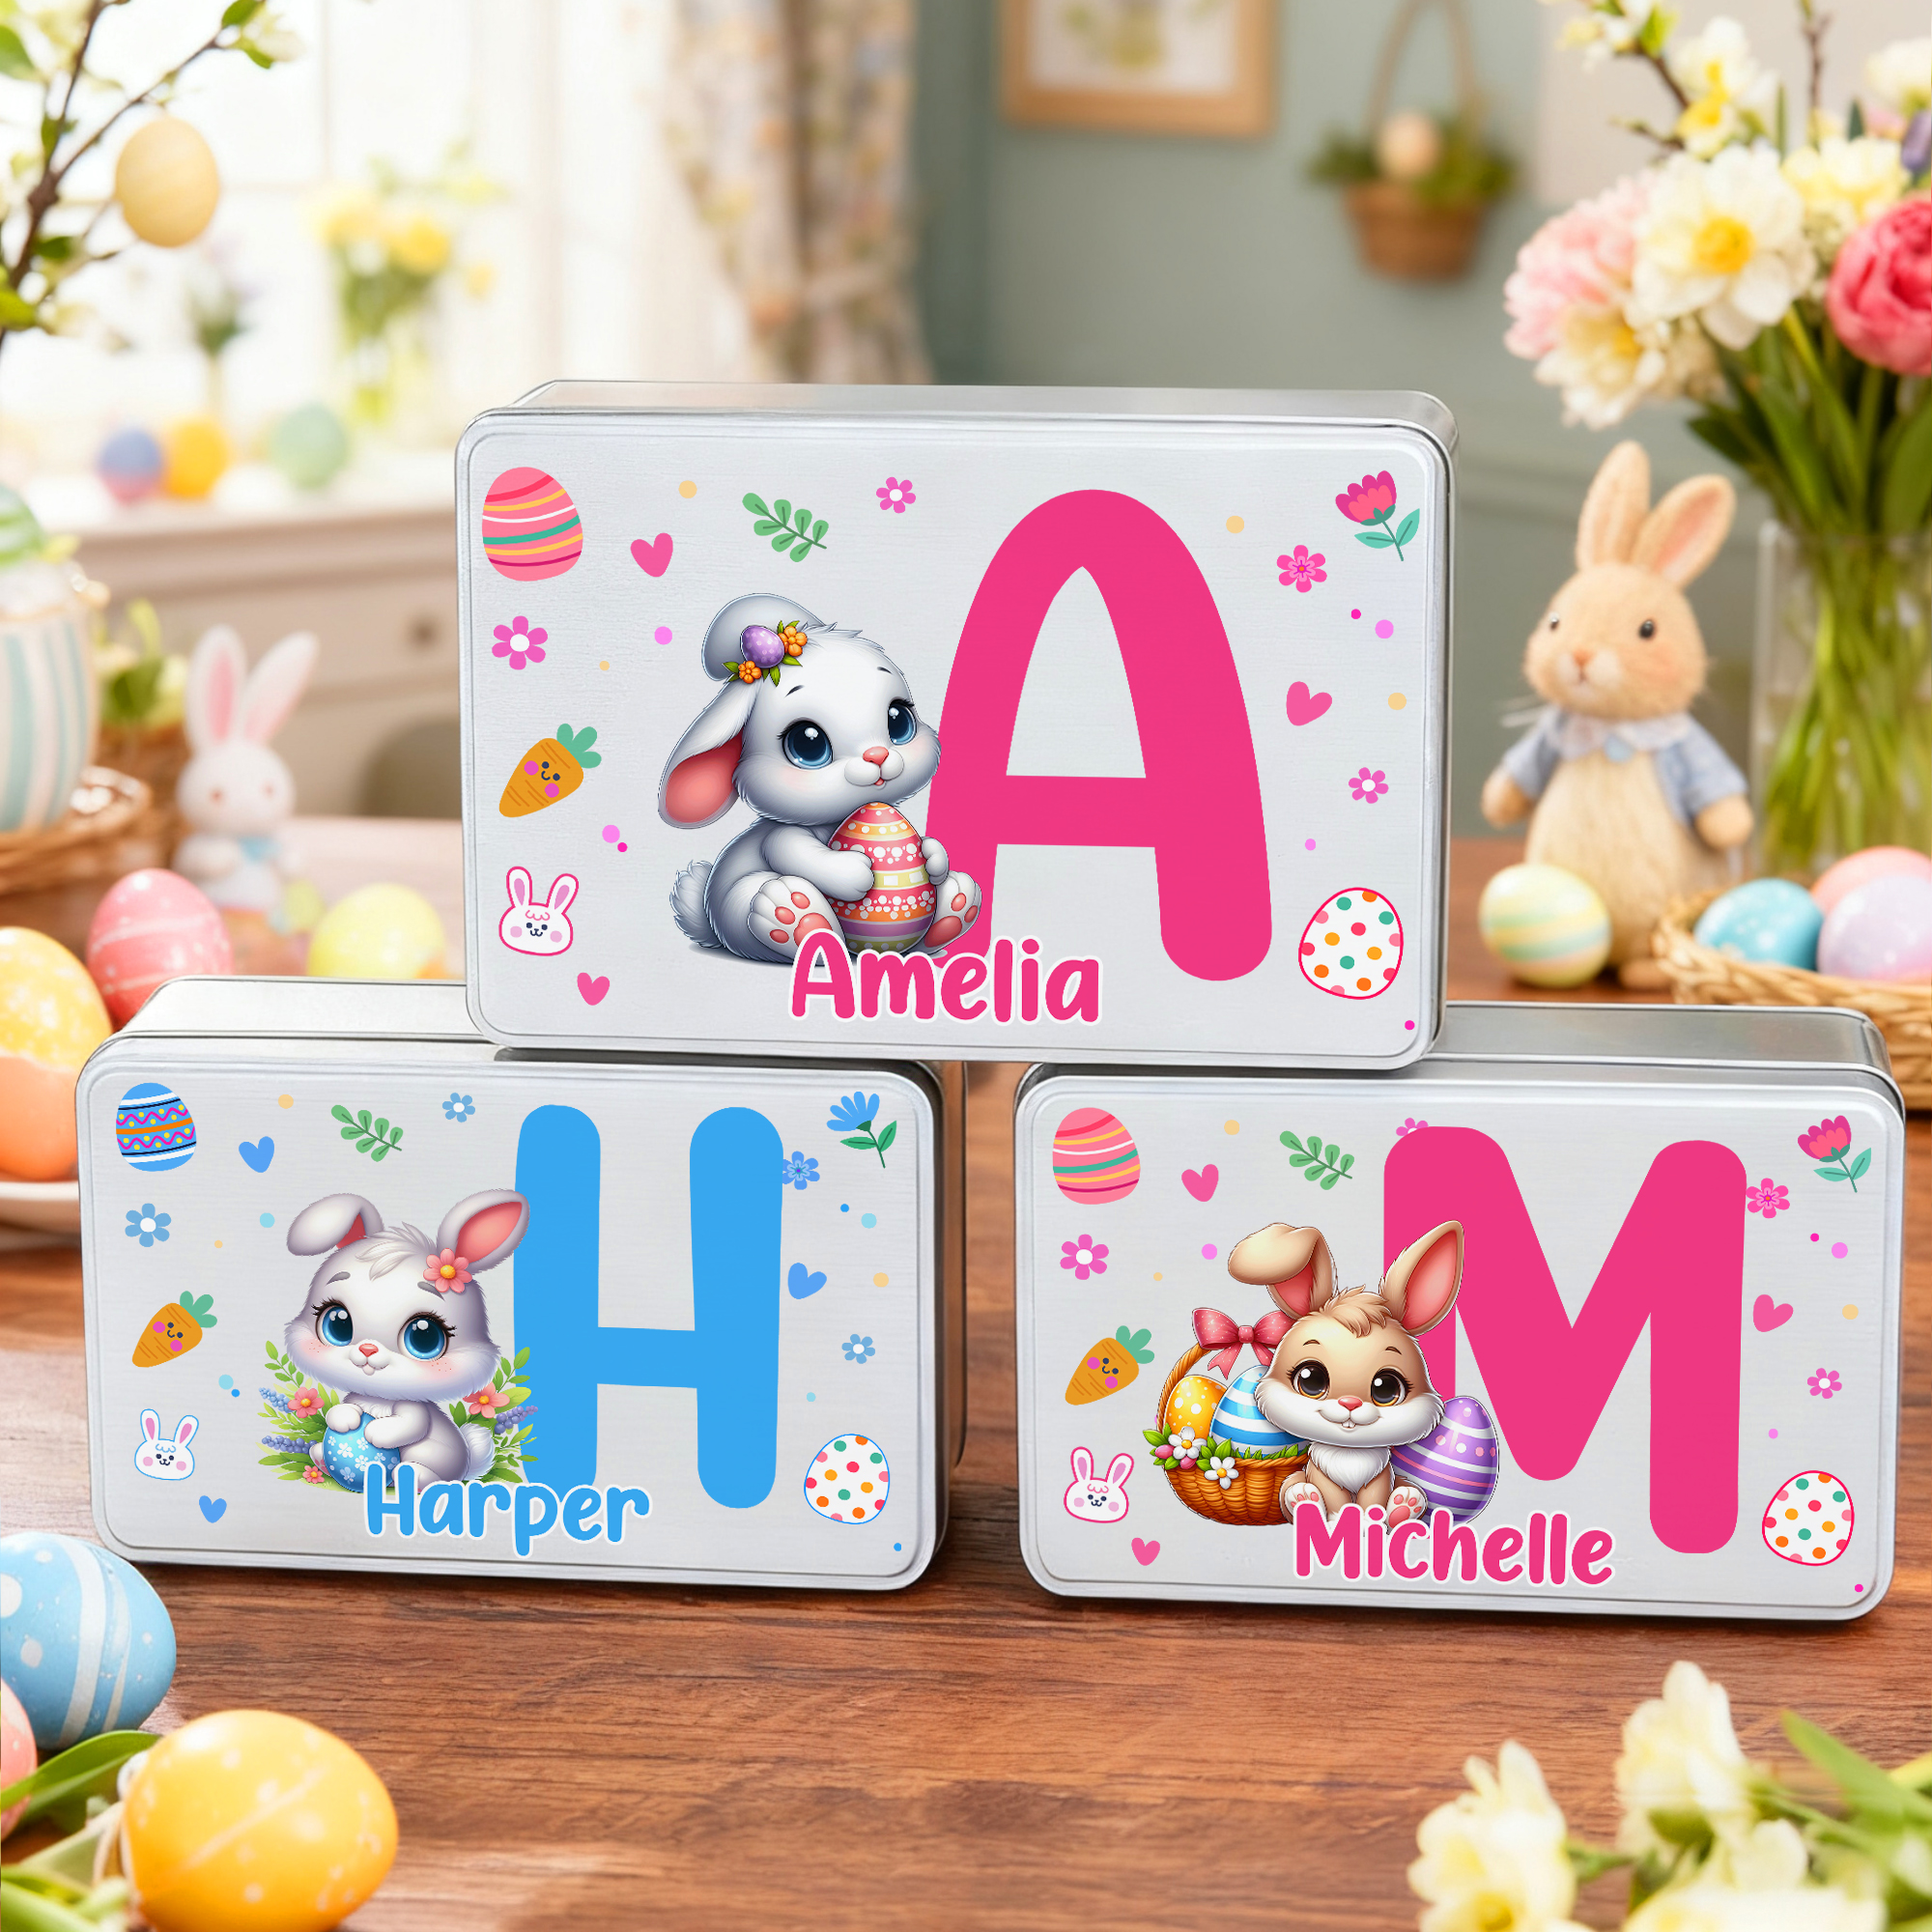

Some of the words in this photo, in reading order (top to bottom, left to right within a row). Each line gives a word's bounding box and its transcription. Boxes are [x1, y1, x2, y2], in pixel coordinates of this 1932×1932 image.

[924, 489, 1272, 981] A
[790, 930, 1100, 1023] Amelia
[513, 1104, 783, 1509] H
[1383, 1125, 1747, 1554] M
[365, 1463, 650, 1555] Harper
[1294, 1503, 1614, 1585] Michelle
